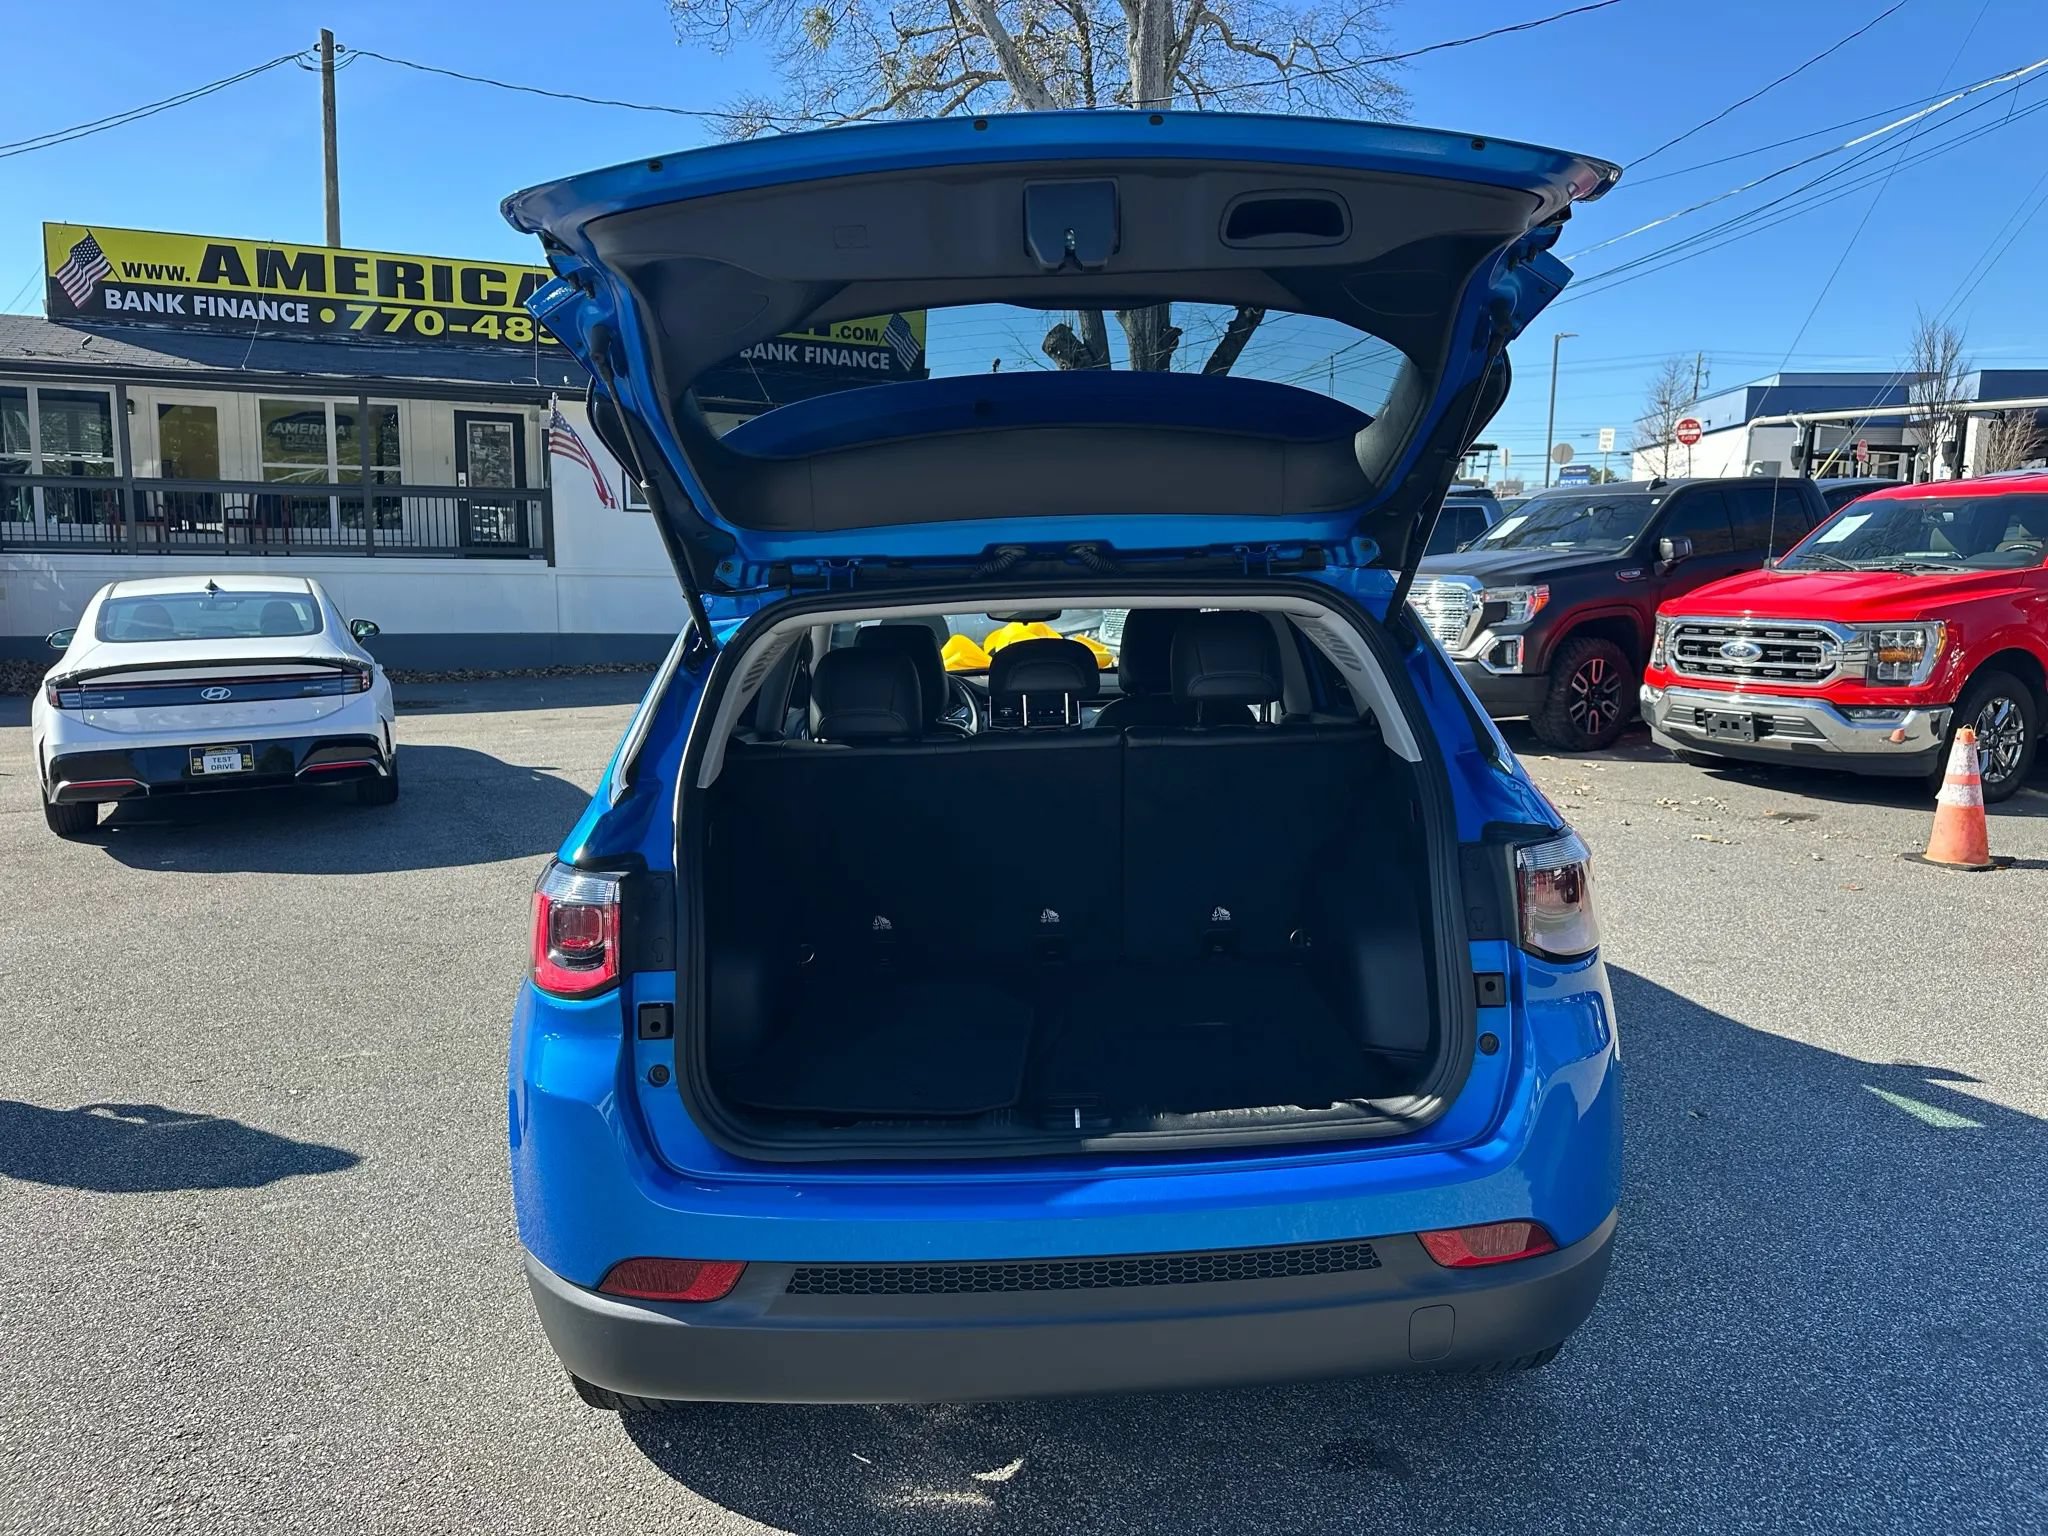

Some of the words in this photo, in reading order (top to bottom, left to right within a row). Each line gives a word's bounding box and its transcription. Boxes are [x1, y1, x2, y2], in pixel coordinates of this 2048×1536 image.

[121, 261, 191, 283] www.
[104, 288, 186, 315] BANK
[193, 295, 310, 324] FINANCE
[835, 325, 879, 342] .COM
[804, 346, 890, 370] FINANCE
[272, 422, 346, 436] AMERIA
[211, 763, 235, 771] DRIVE
